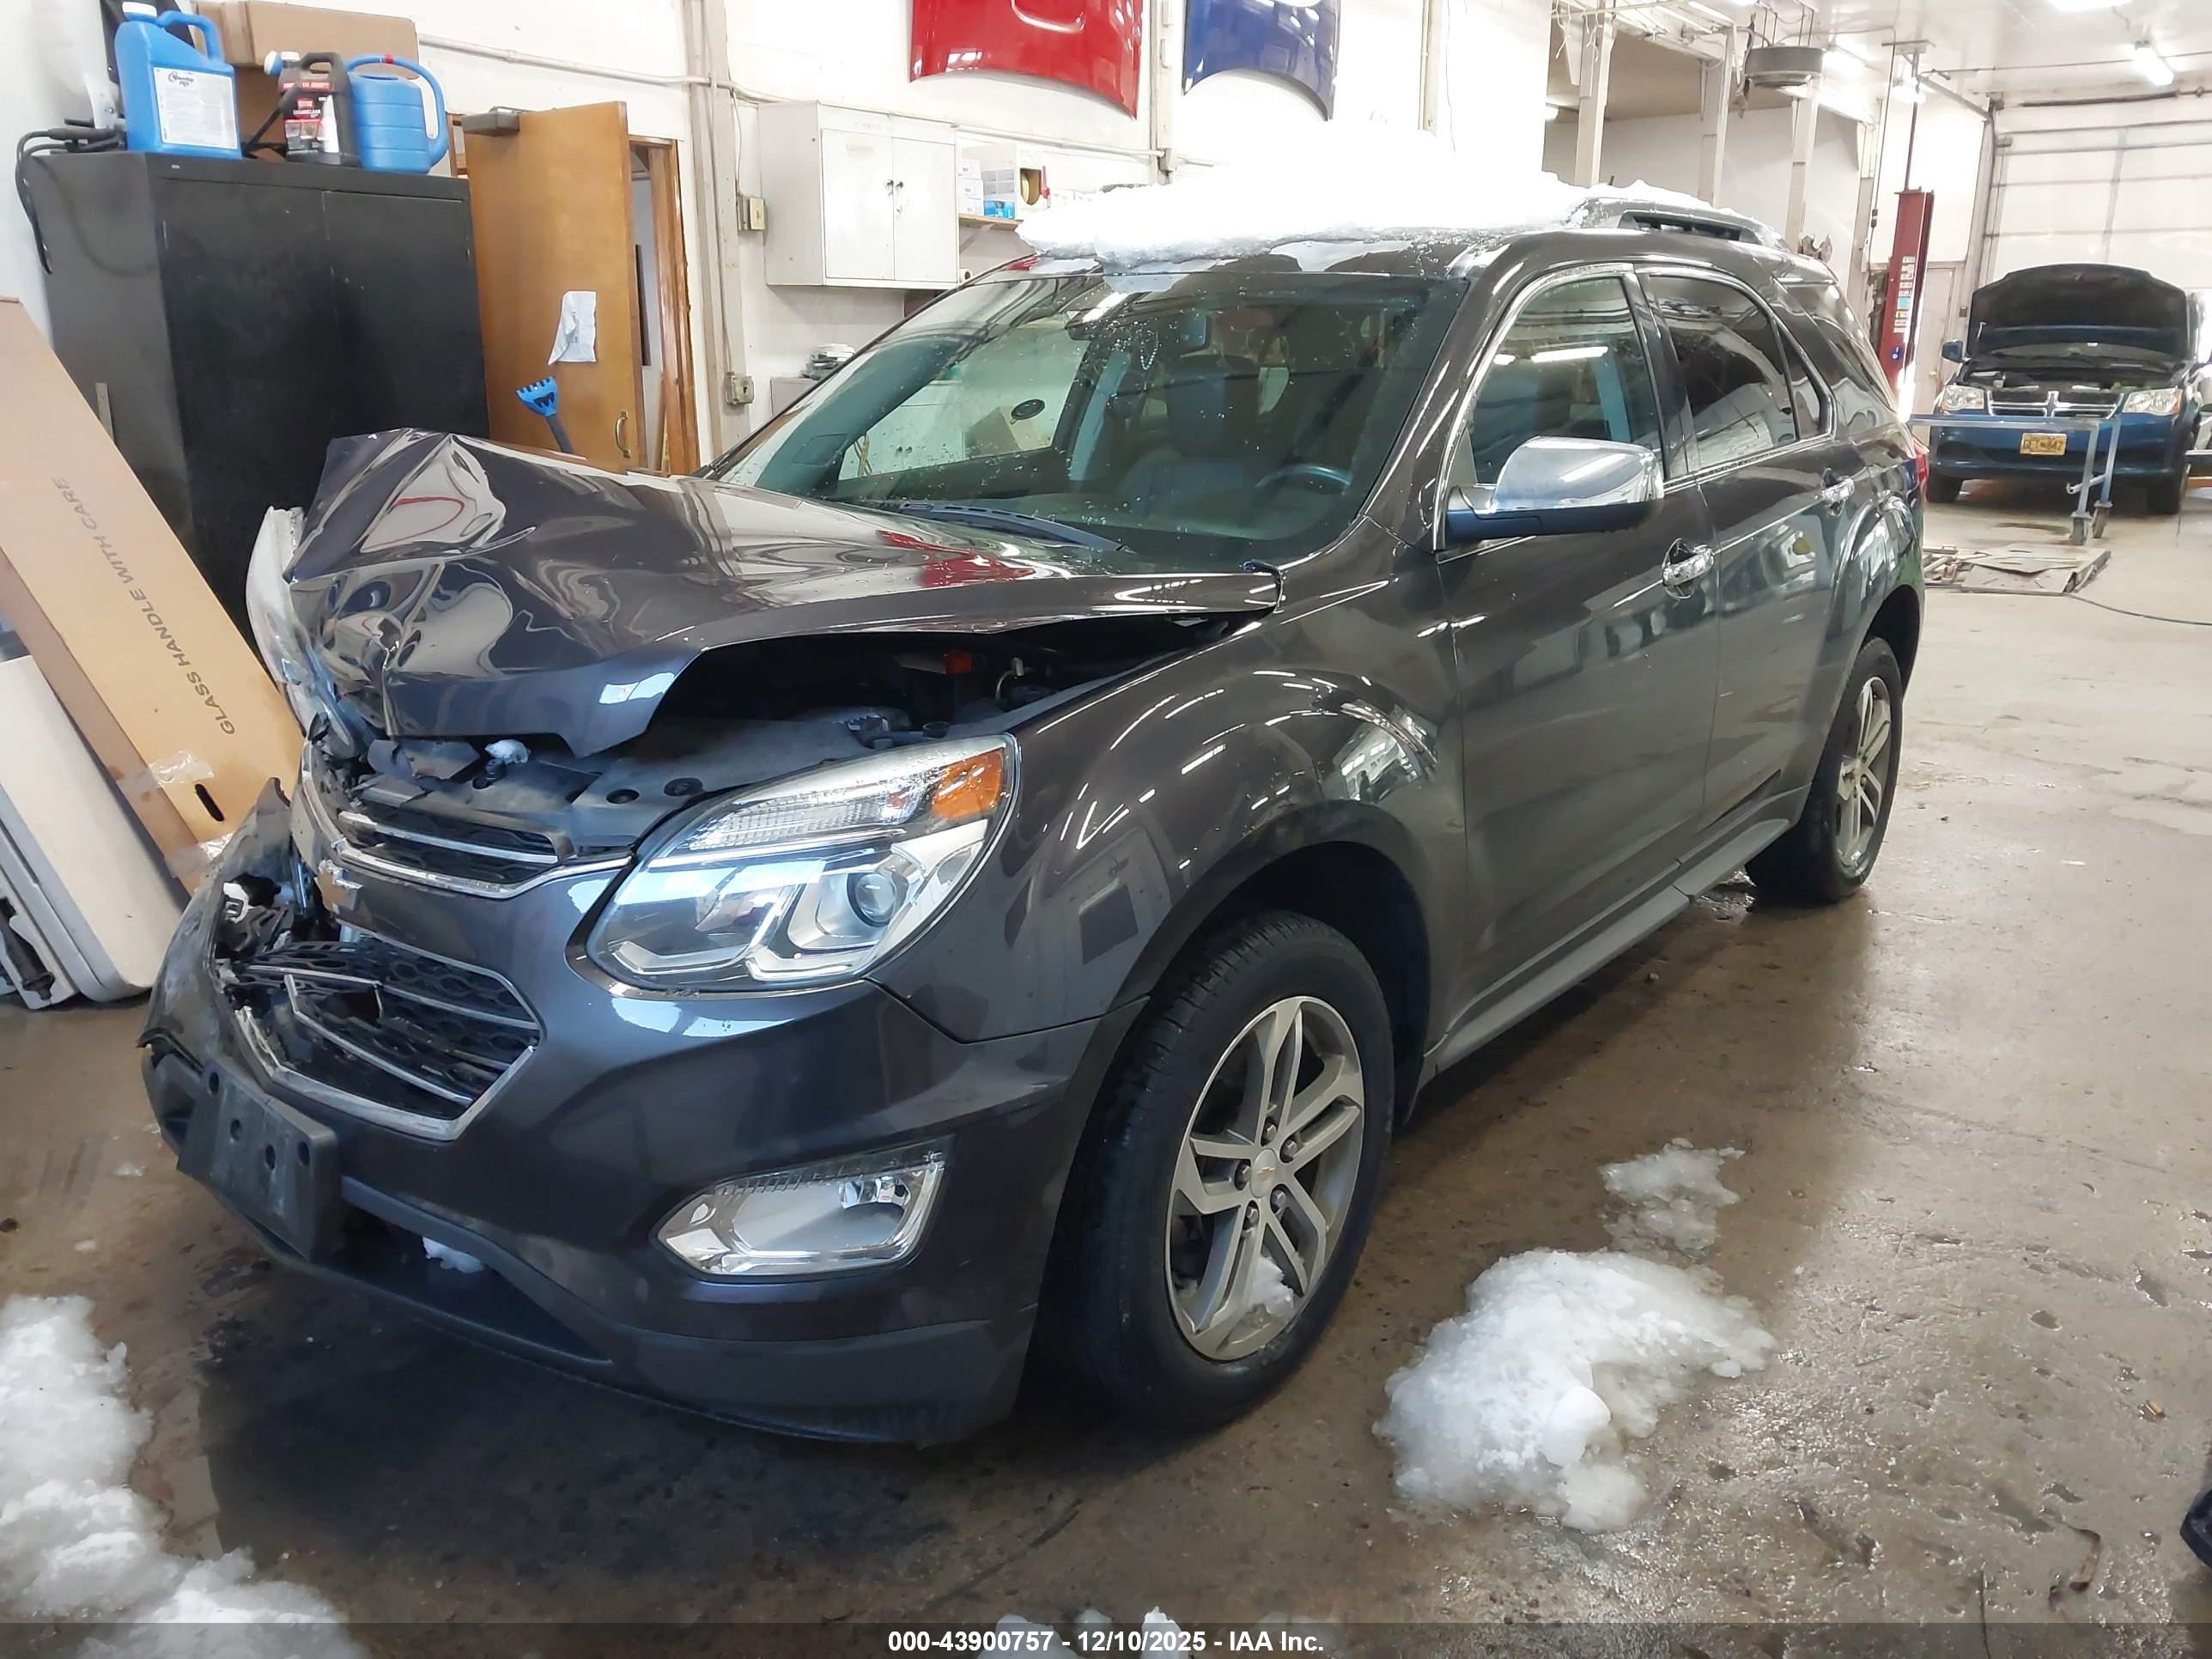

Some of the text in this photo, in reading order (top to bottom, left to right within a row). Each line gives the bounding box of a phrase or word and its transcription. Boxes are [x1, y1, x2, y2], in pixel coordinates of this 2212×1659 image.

[52, 477, 236, 735] GLASS HANDLE WITH CARE
